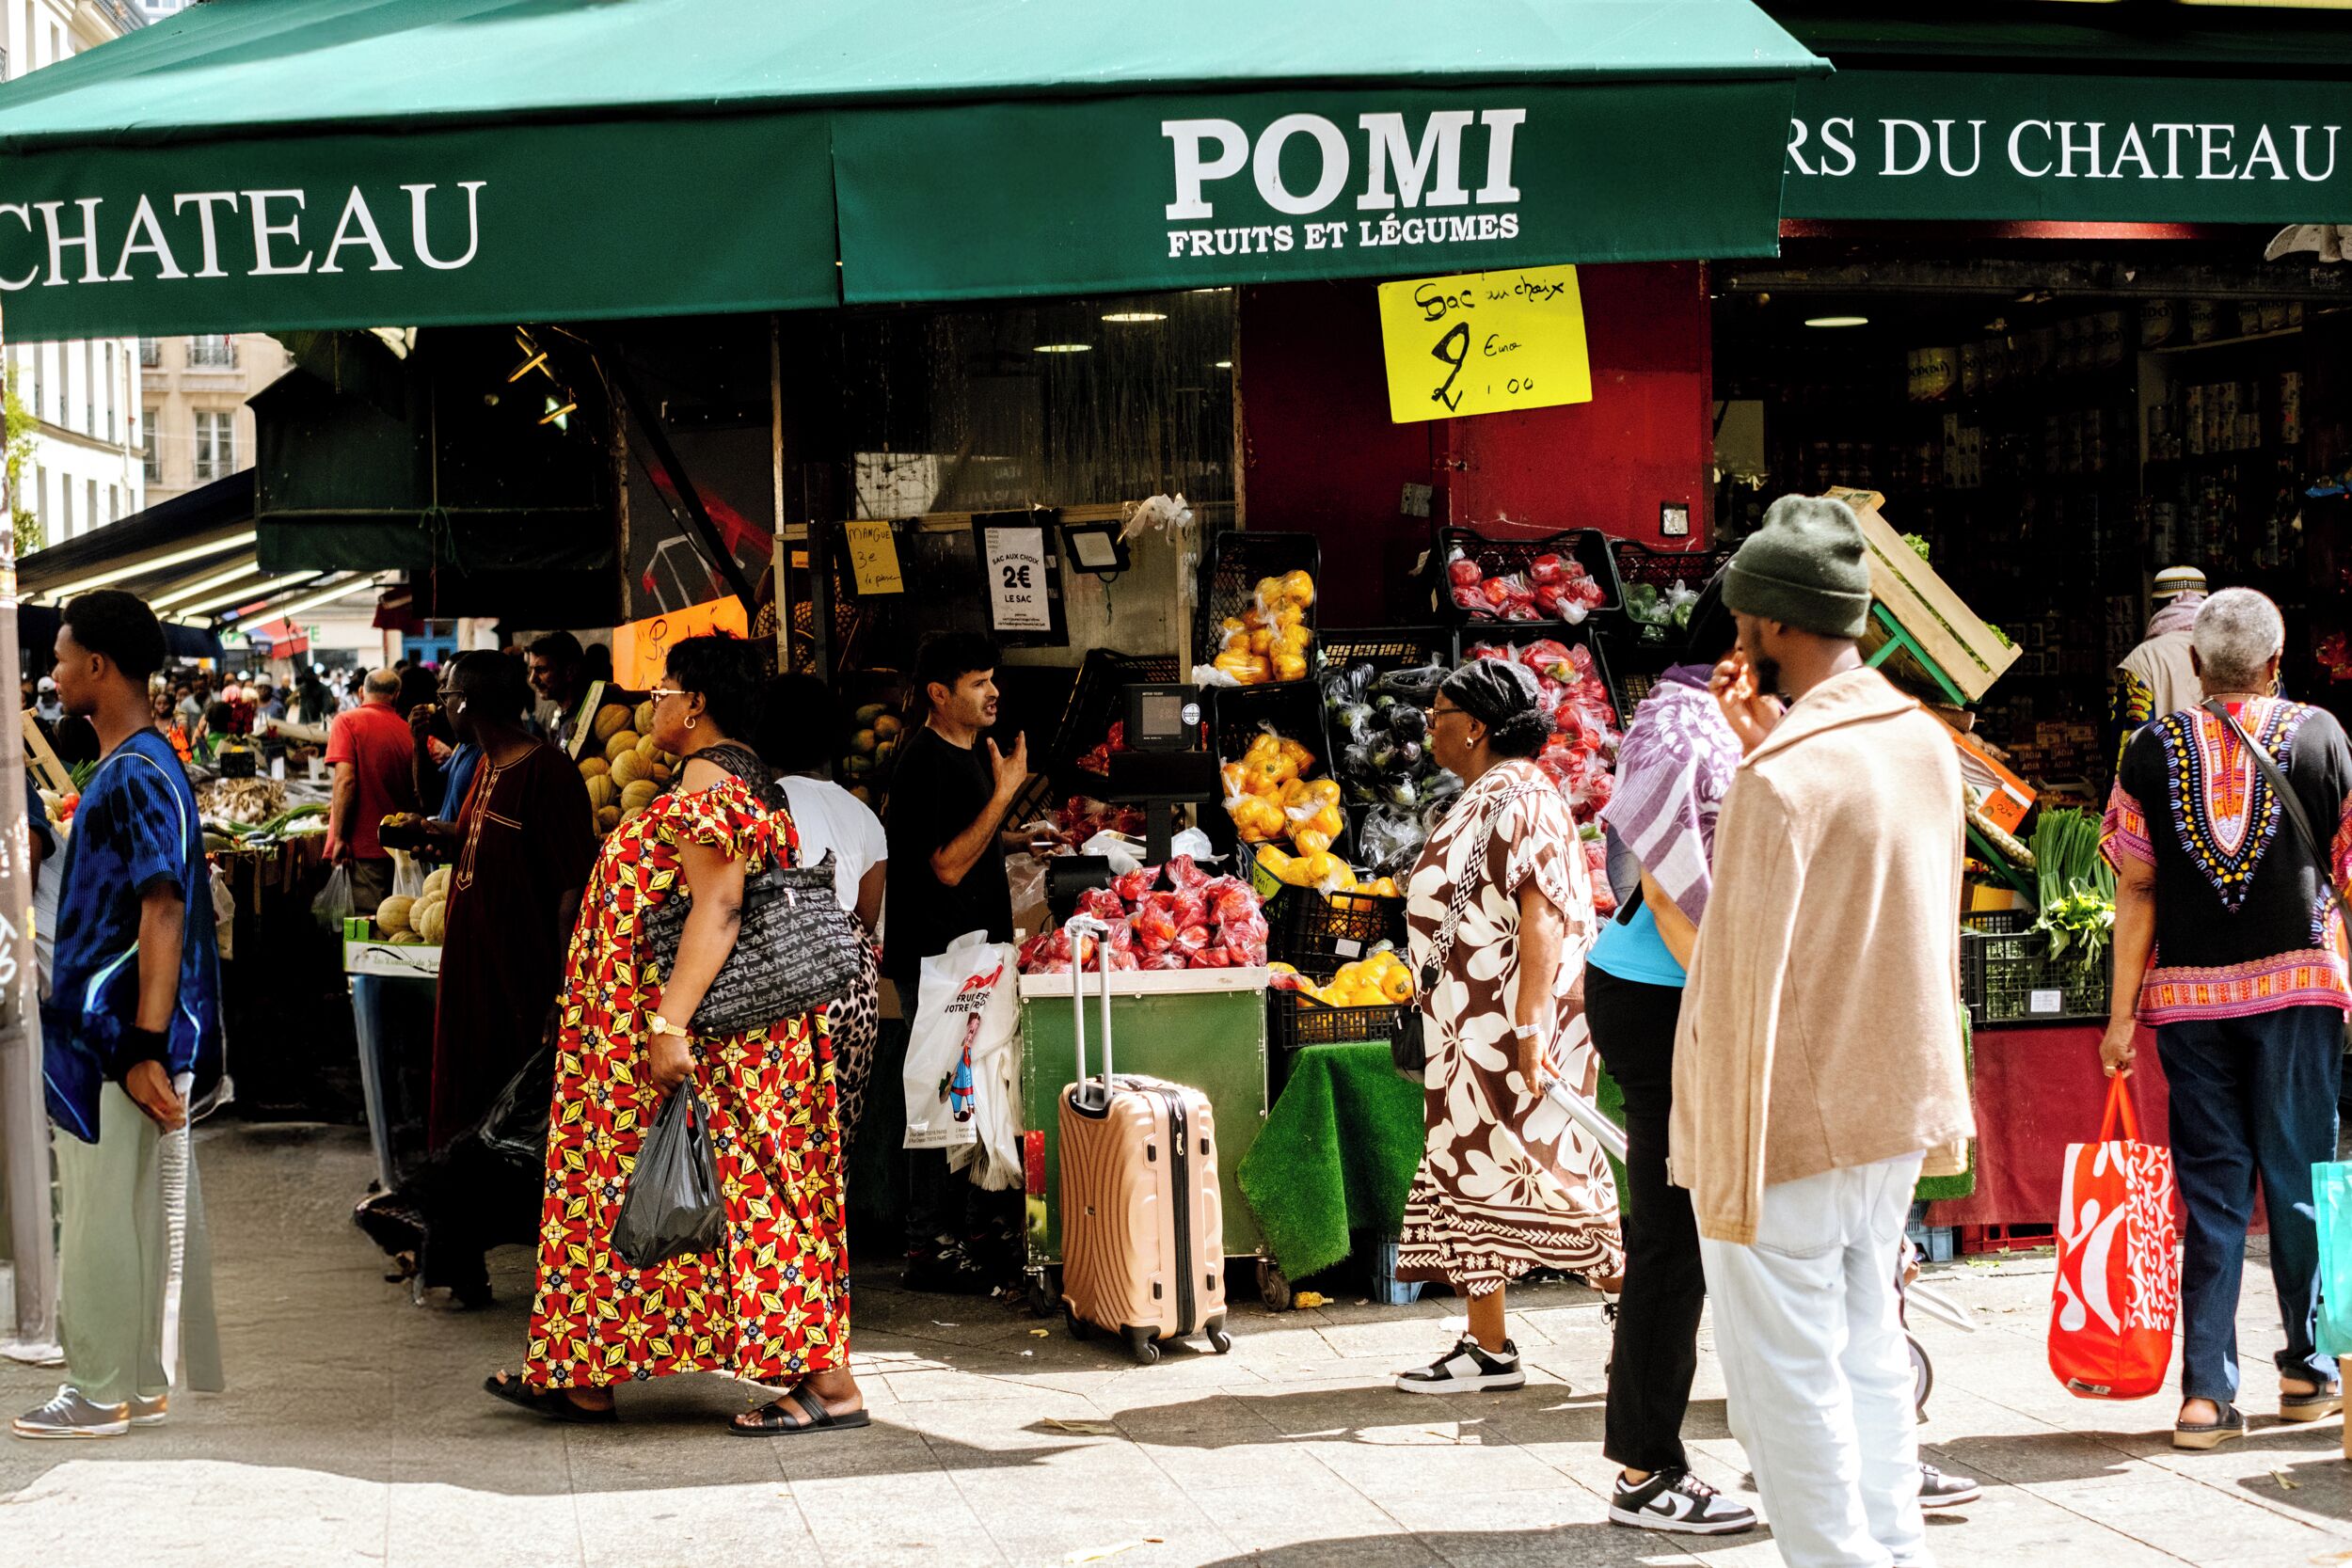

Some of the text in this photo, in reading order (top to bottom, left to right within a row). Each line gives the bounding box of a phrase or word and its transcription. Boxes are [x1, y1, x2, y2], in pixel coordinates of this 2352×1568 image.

[1162, 109, 1527, 220] POMI
[1879, 119, 1986, 177] DU
[2008, 119, 2341, 182] CHATEAU
[0, 181, 487, 291] CHATEAU
[1168, 213, 1519, 258] FRUITS ET LÉGUMES
[1414, 282, 1475, 322] Sac
[1431, 322, 1470, 412] 2
[849, 528, 891, 542] MANGUE
[993, 555, 1005, 565] SAC
[1020, 553, 1040, 565] CHOIX
[1003, 565, 1031, 588] 2€
